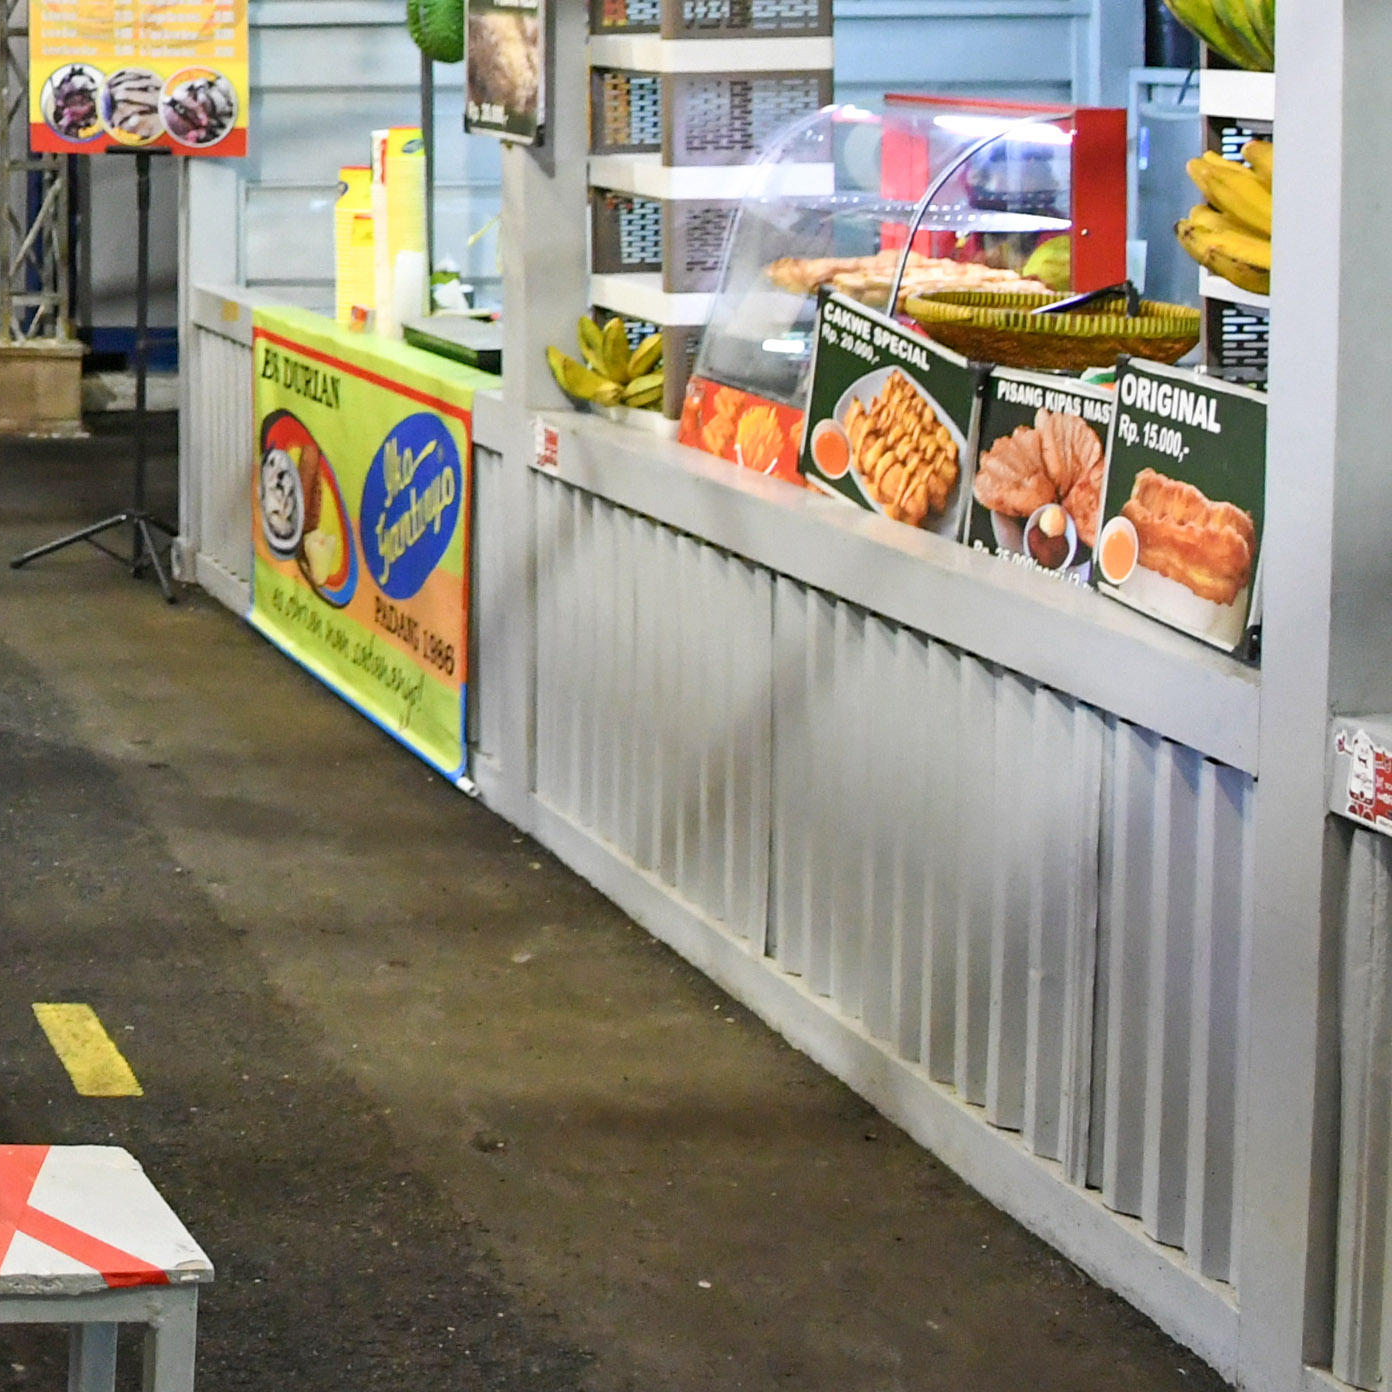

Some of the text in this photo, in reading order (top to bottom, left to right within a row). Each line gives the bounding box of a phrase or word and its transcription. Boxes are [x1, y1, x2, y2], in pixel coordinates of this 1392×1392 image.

[822, 322, 839, 345] Rp.
[823, 302, 930, 372] CAKWE SPECIAL
[282, 356, 341, 411] DURIAN
[997, 379, 1043, 408] PISANG
[1045, 390, 1082, 417] KIPAS
[1120, 373, 1221, 434] ORIGINAL
[1118, 414, 1190, 464] Rp. 15.000,-
[375, 596, 420, 651] PADANG
